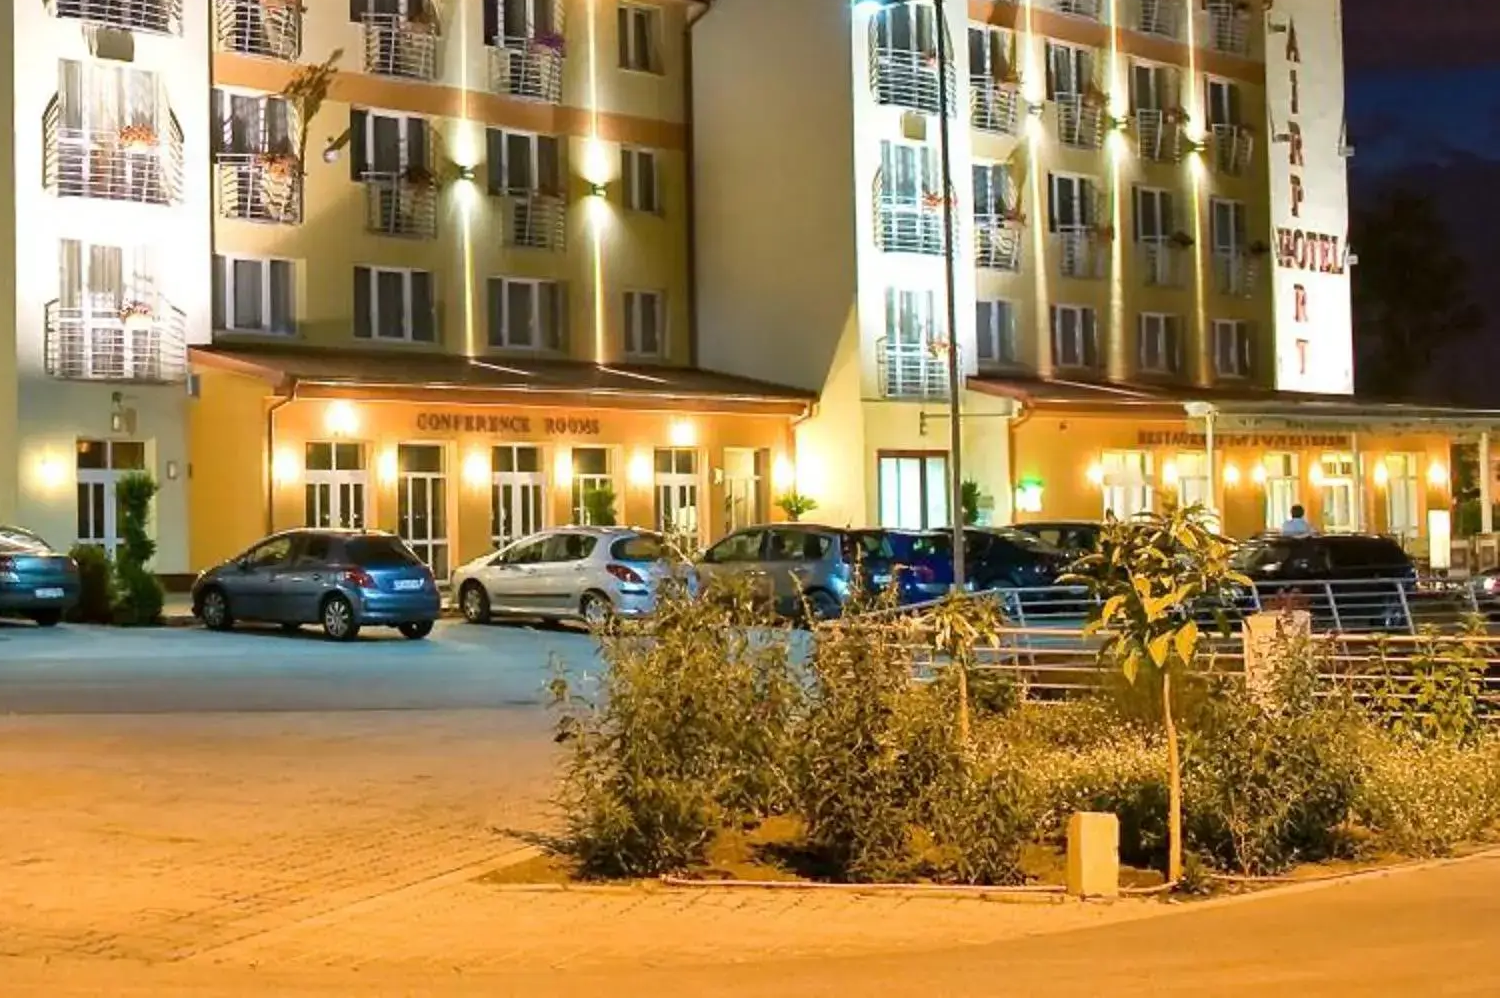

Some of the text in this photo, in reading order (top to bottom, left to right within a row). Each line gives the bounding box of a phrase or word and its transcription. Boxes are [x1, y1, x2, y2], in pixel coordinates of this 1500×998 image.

[1276, 227, 1344, 274] HOTEL
[417, 413, 601, 435] CONFERENCE ROOMS
